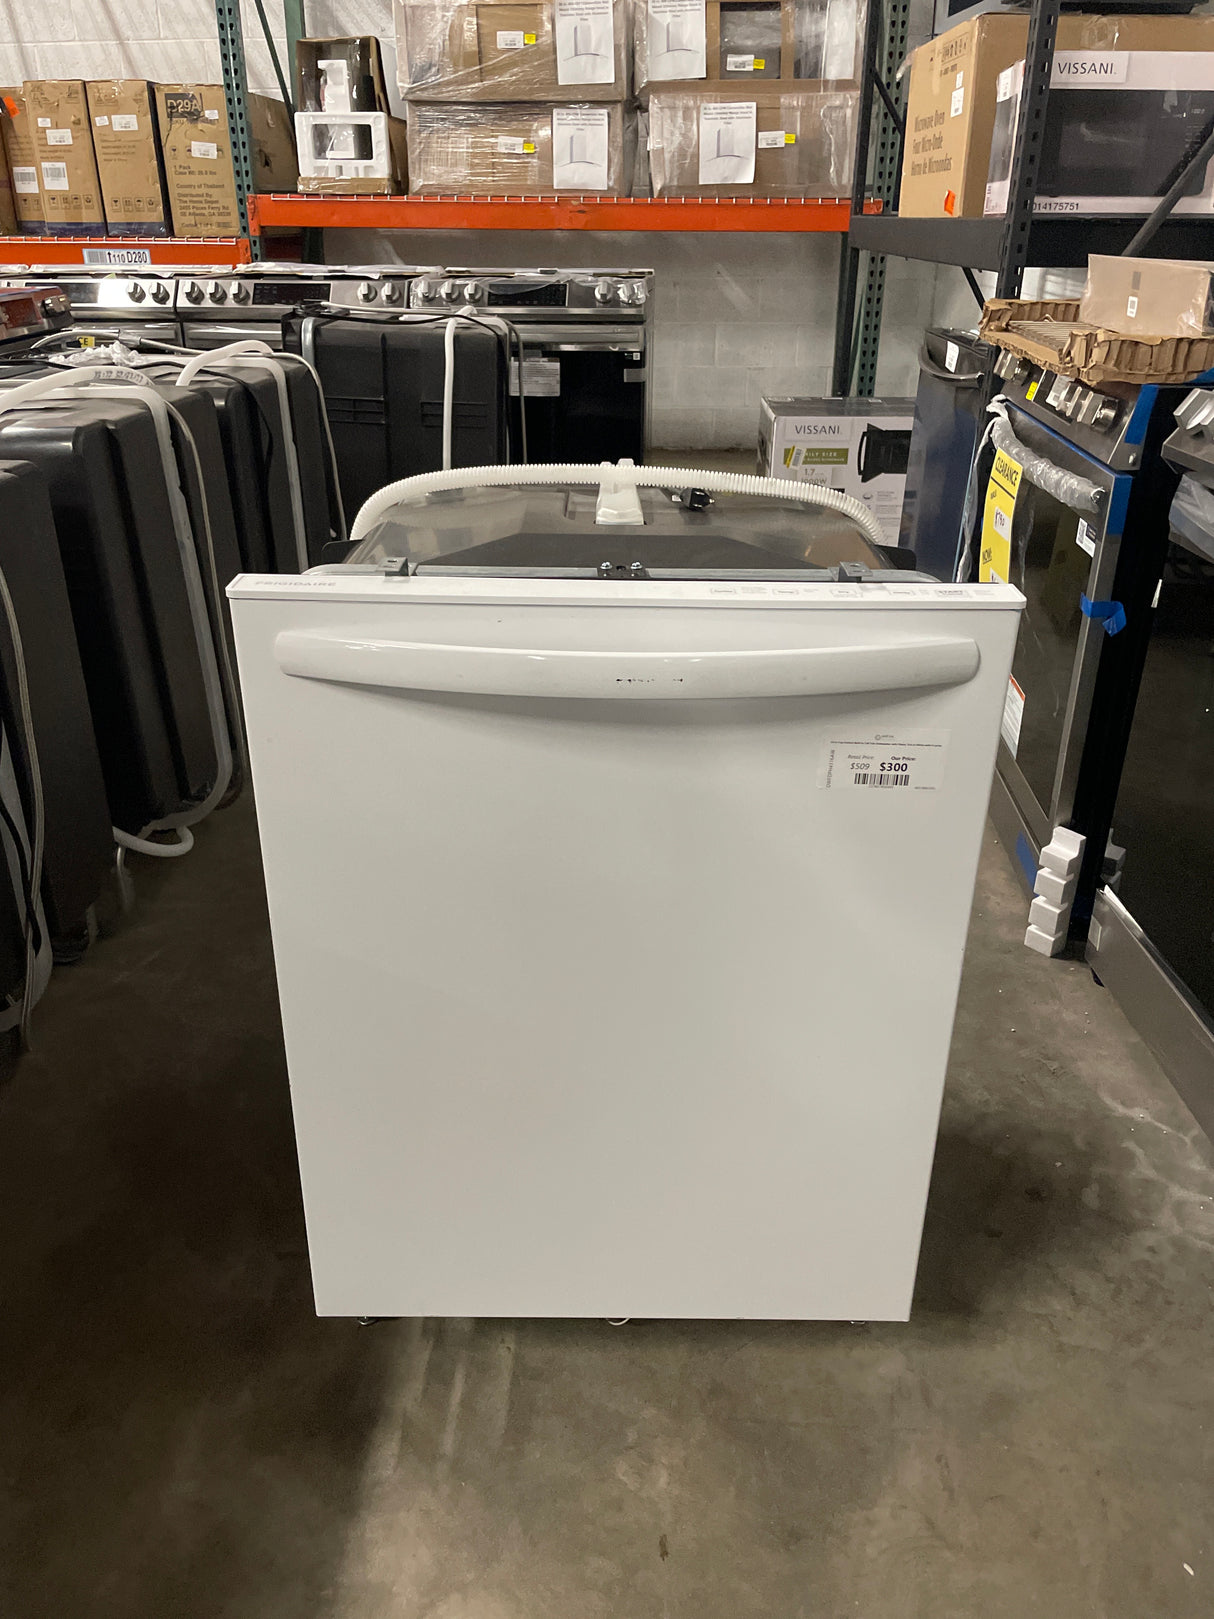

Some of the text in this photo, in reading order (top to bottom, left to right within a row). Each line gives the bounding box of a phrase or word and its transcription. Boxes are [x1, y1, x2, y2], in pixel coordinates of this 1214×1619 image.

[1057, 62, 1114, 75] VISSANI
[167, 99, 201, 113] D29A
[113, 251, 148, 264] 110 D280
[795, 425, 840, 435] VISSANI
[995, 456, 1019, 487] CLEARANCE
[850, 762, 908, 772] $509 $300
